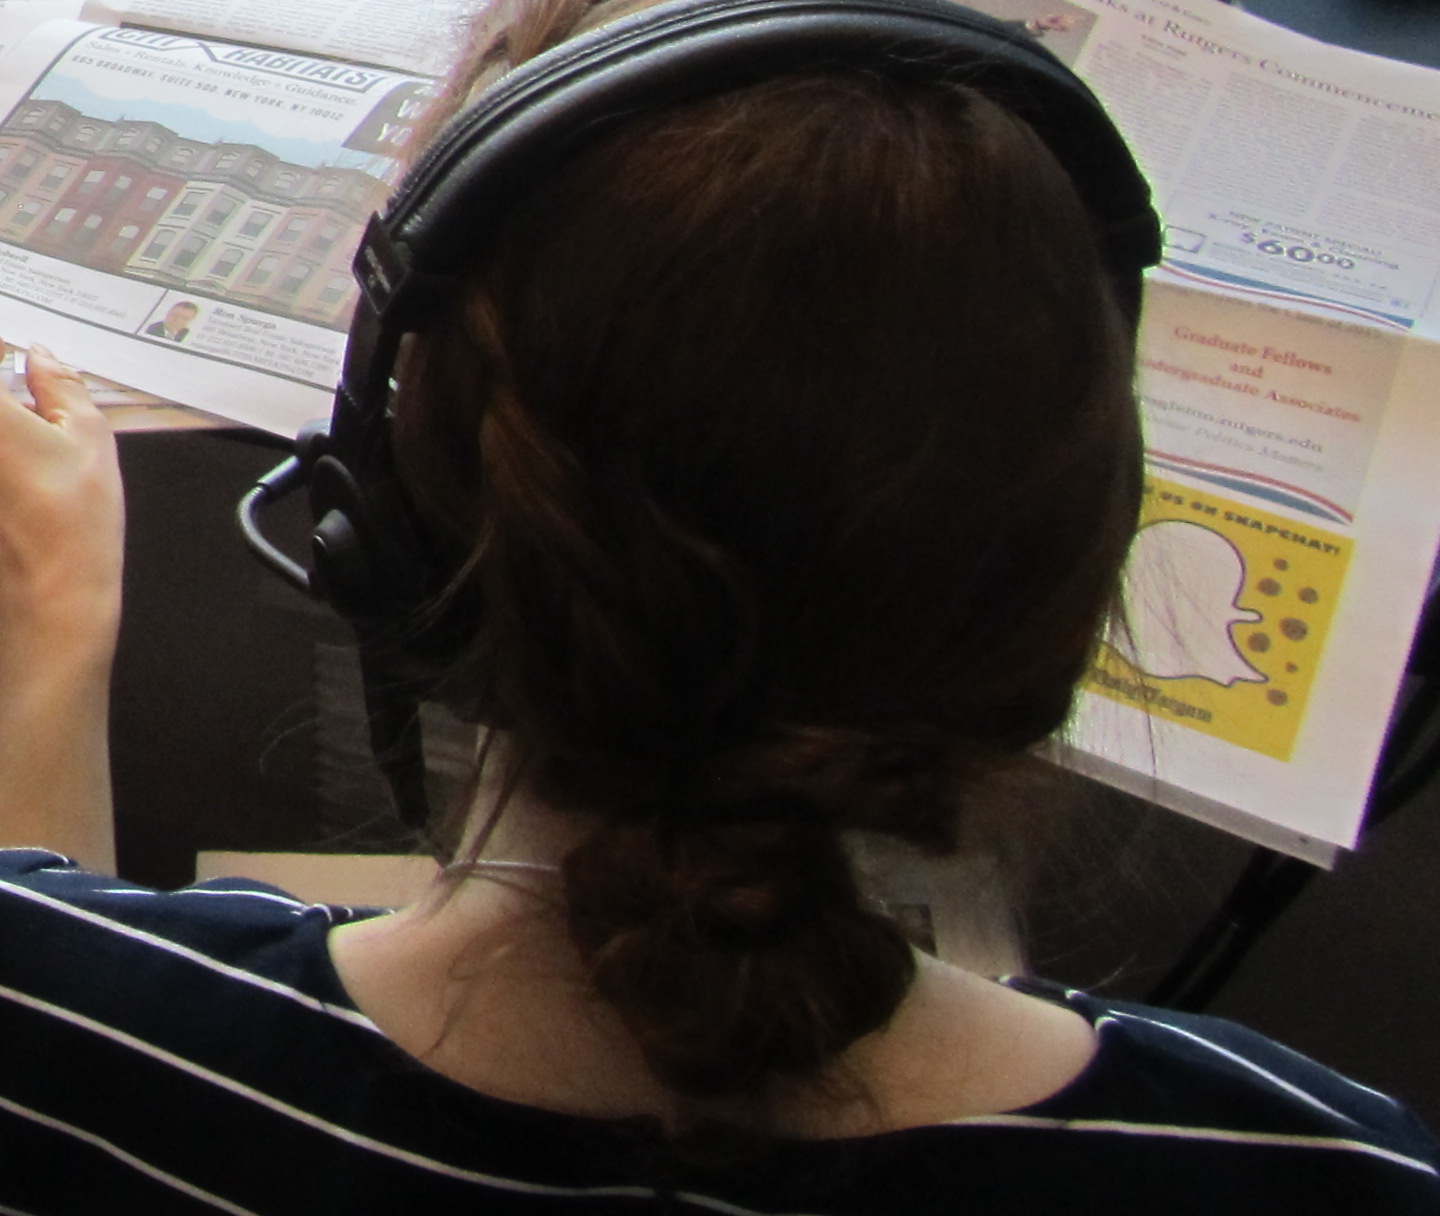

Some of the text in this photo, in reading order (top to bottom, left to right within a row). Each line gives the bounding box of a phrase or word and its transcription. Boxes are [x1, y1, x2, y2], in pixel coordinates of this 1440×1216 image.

[1133, 10, 1155, 26] at
[1163, 19, 1254, 65] Rutgers
[84, 40, 121, 56] Sales
[193, 62, 272, 90] Knowledge
[159, 72, 193, 89] SUITE
[223, 88, 252, 103] NEW
[290, 102, 308, 114] NY
[310, 107, 346, 123] 10012
[1174, 325, 1333, 376] Graduate Fellows
[1229, 362, 1264, 378] and
[1266, 390, 1362, 423] Associates
[1223, 510, 1341, 556] SNAPCHAT!
